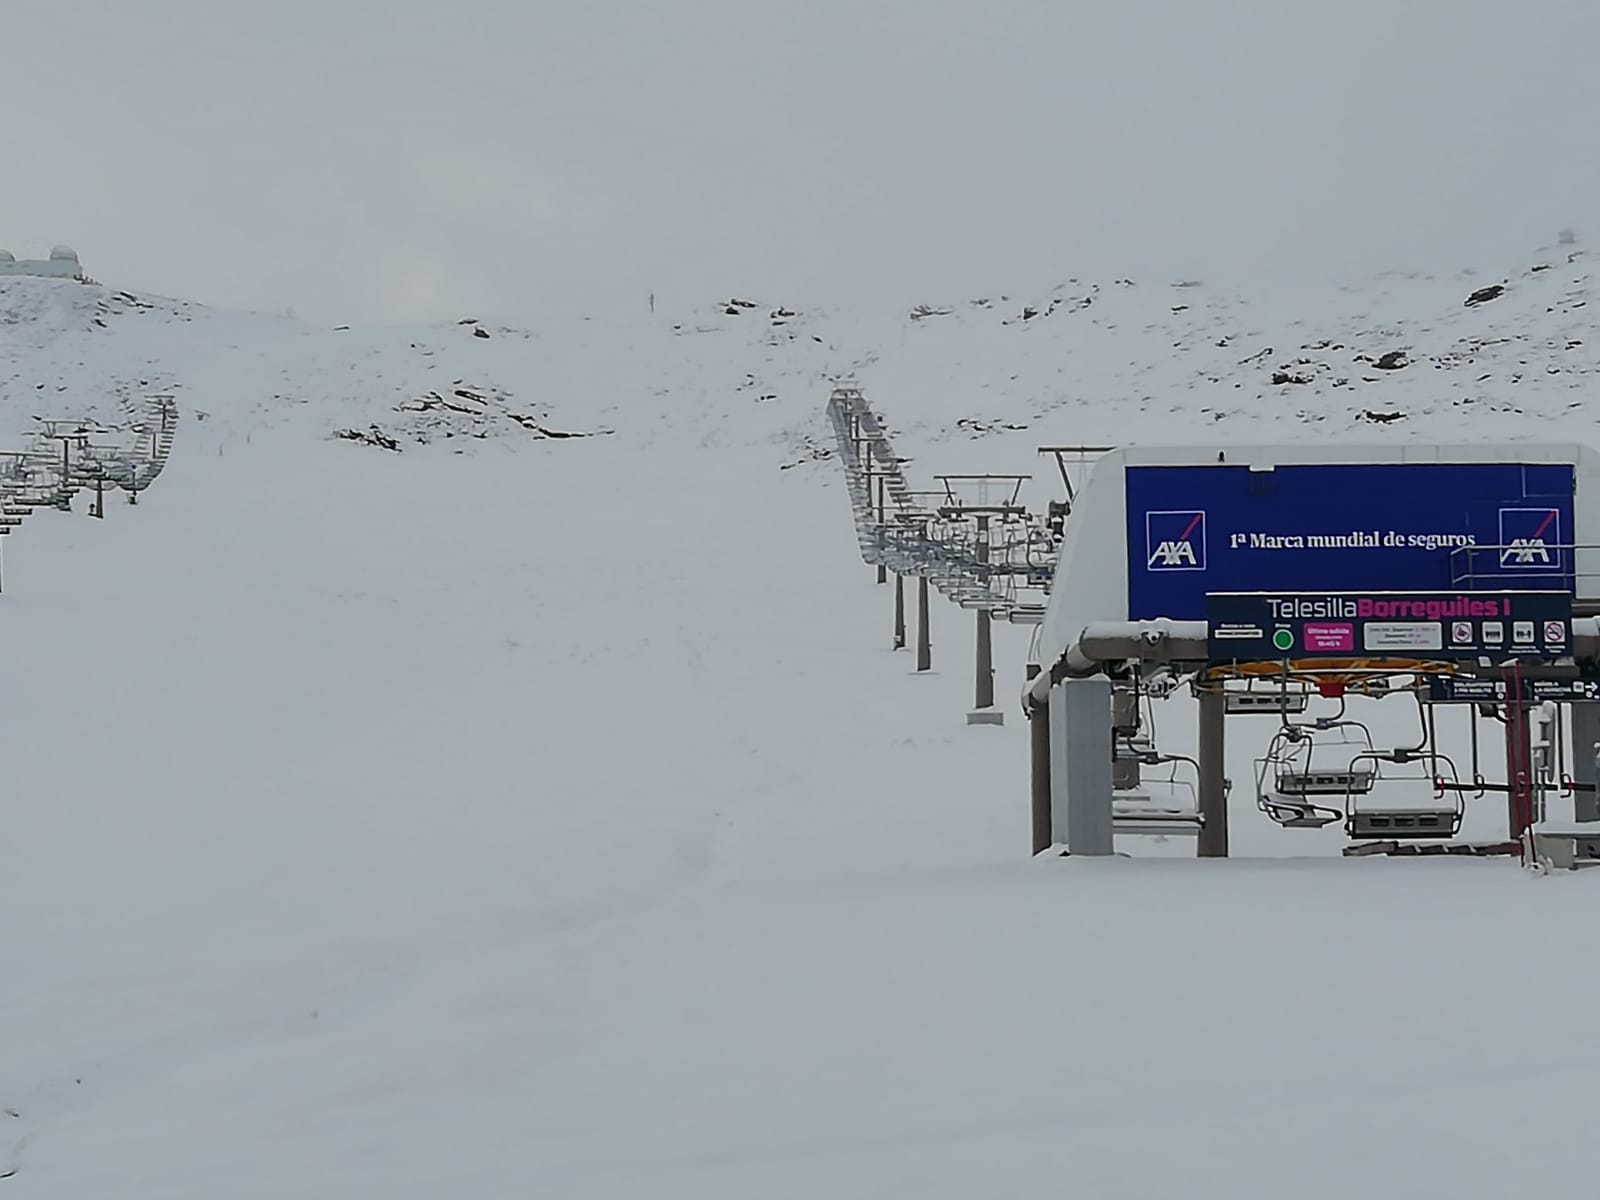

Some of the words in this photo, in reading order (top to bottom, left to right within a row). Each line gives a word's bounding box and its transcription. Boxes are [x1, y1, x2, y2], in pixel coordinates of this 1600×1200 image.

[1250, 533, 1304, 549] Marca
[1307, 531, 1380, 548] mundial
[1383, 531, 1406, 547] de
[1408, 534, 1476, 550] seguros
[1500, 539, 1550, 563] AXA
[1148, 541, 1197, 565] AXA
